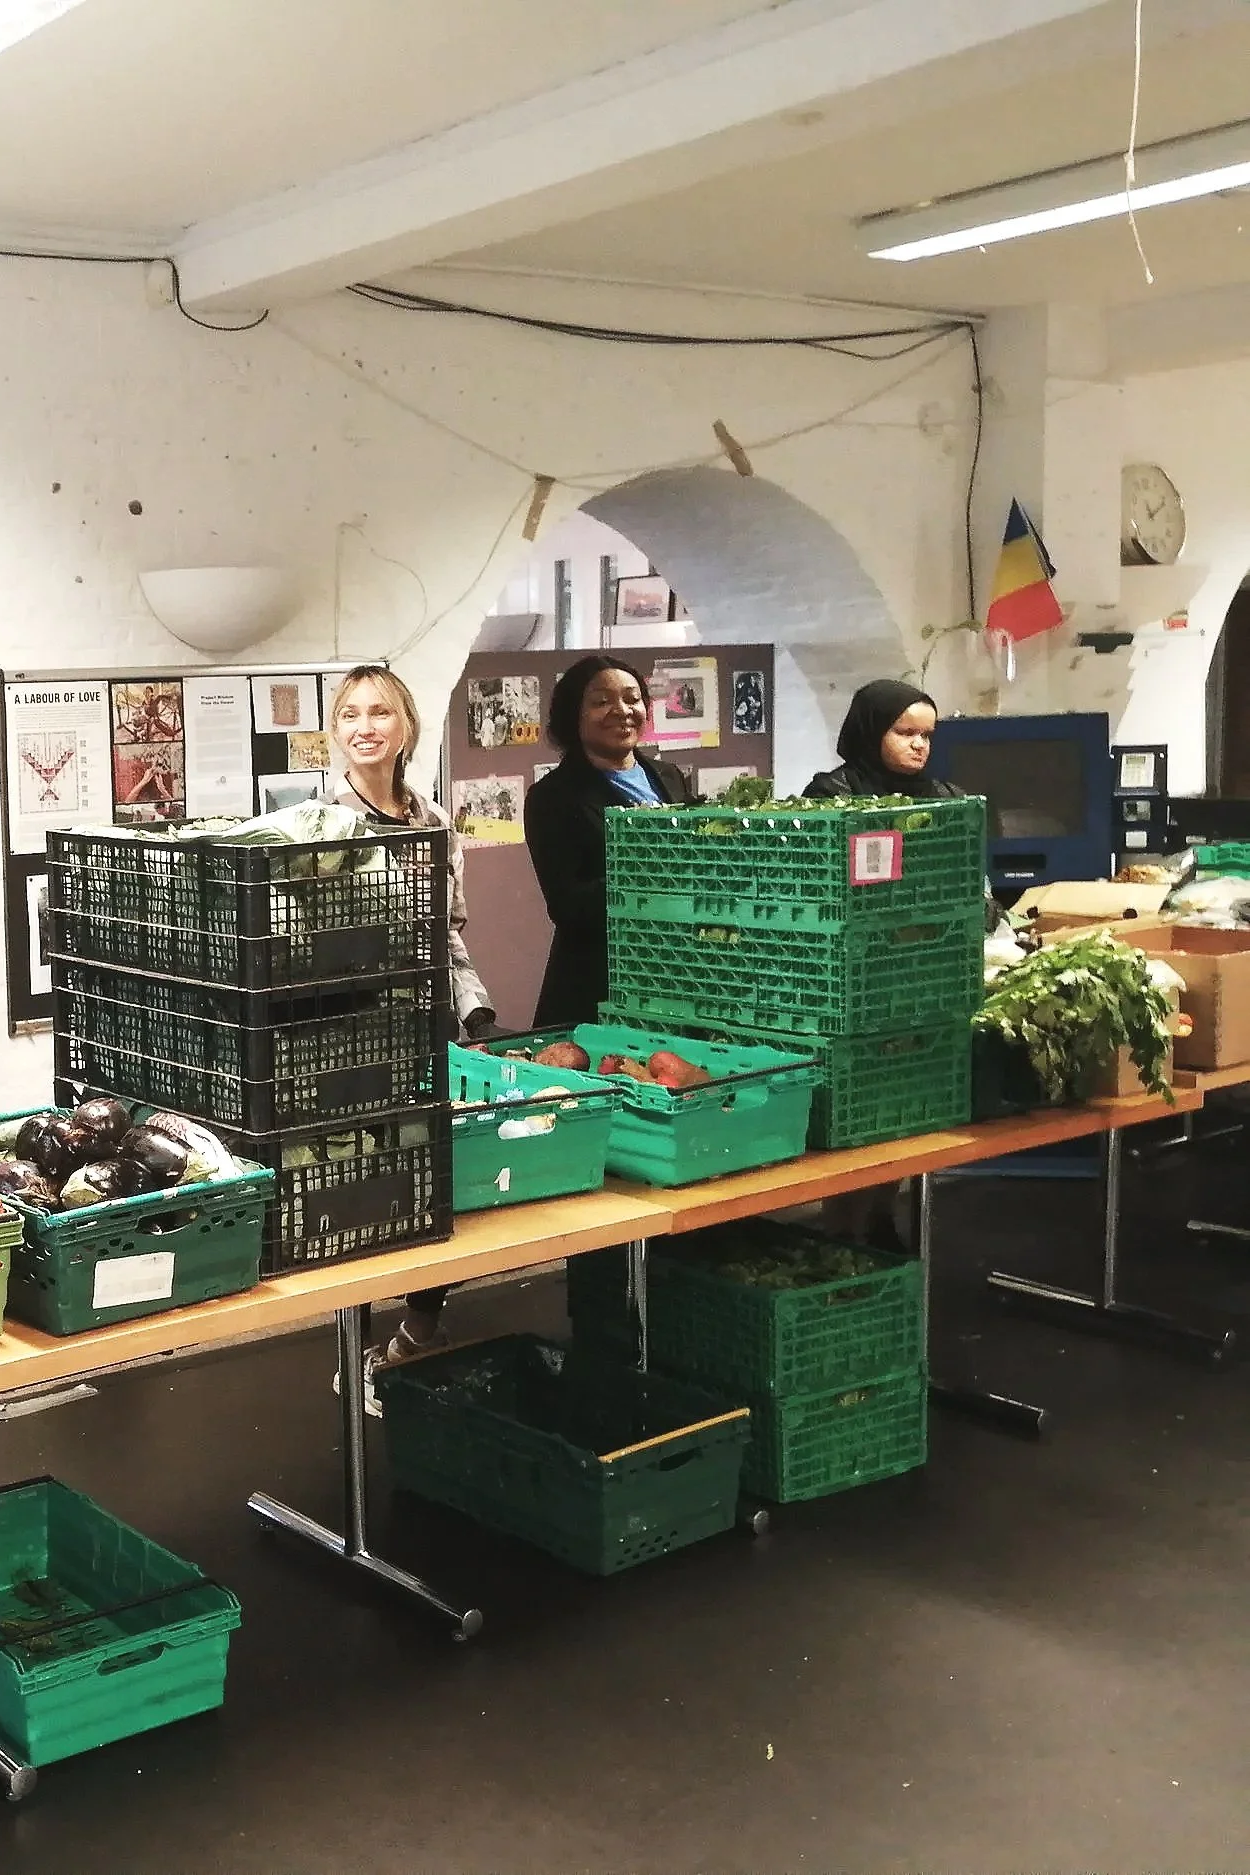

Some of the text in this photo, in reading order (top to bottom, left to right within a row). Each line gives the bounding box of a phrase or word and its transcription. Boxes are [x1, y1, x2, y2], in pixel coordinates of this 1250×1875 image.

[14, 691, 101, 705] A LABOUR OF LOVE
